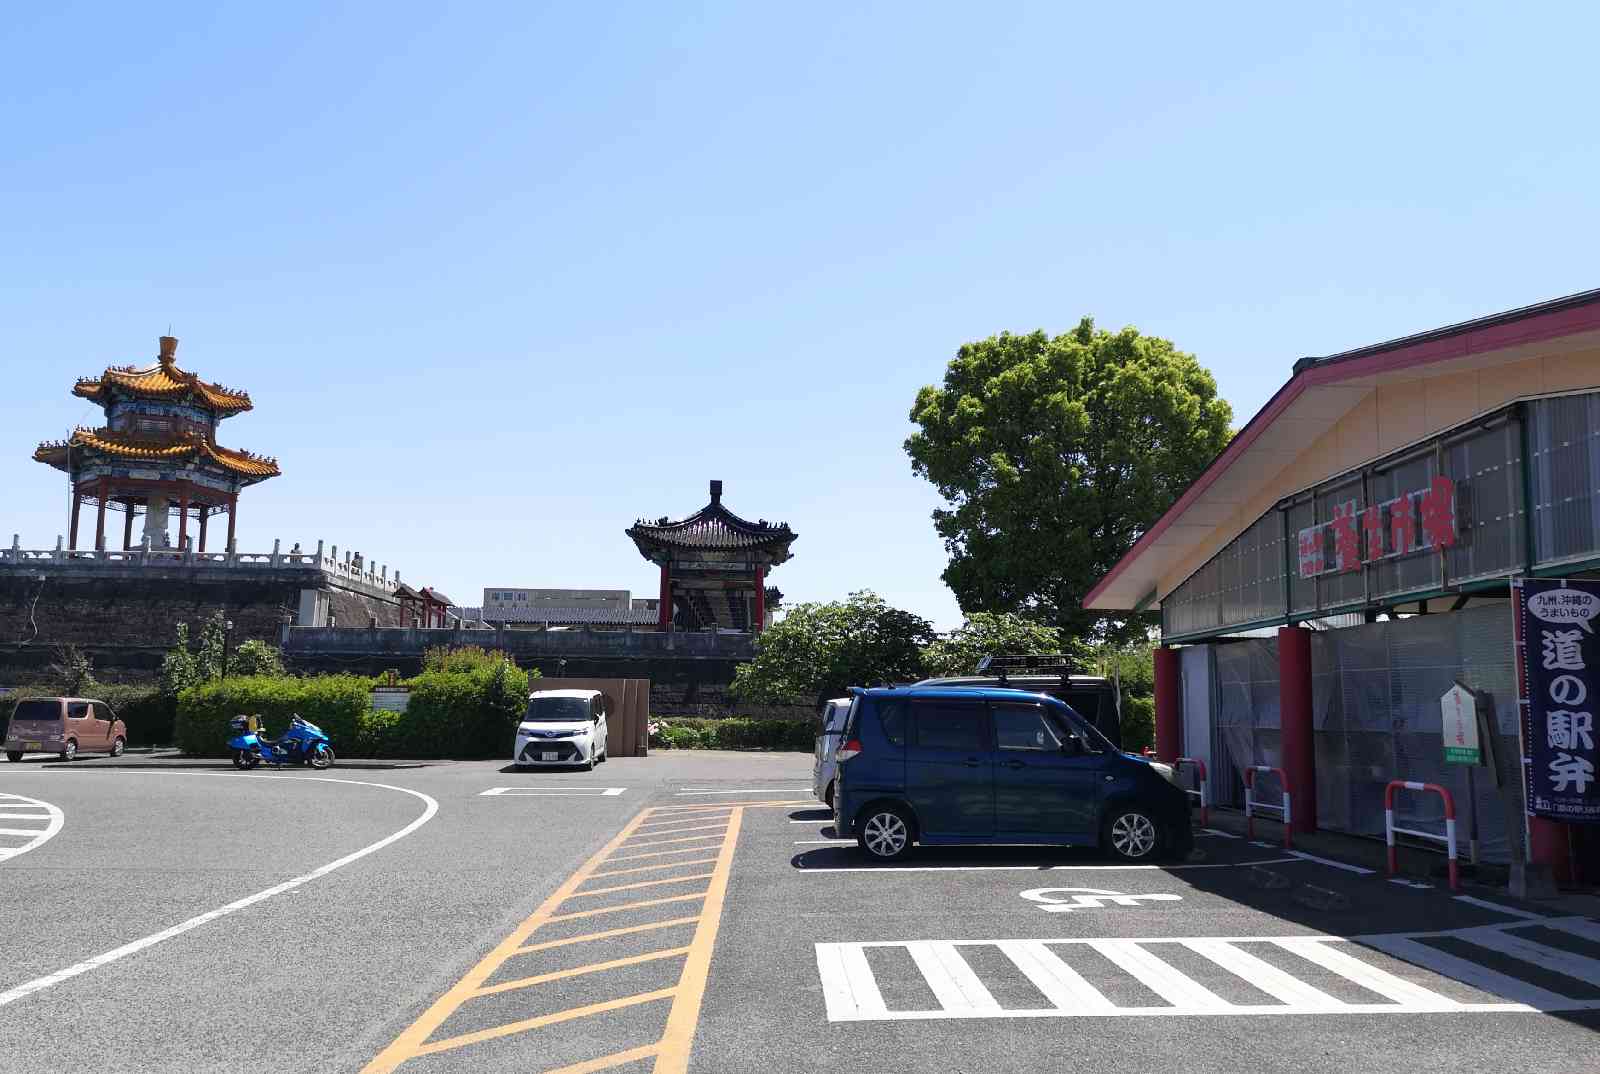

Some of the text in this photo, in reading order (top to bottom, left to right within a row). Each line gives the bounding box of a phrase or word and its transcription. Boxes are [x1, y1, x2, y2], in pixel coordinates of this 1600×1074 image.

[1539, 607, 1590, 618] うまいもの
[1541, 629, 1595, 793] 道の駅弁
